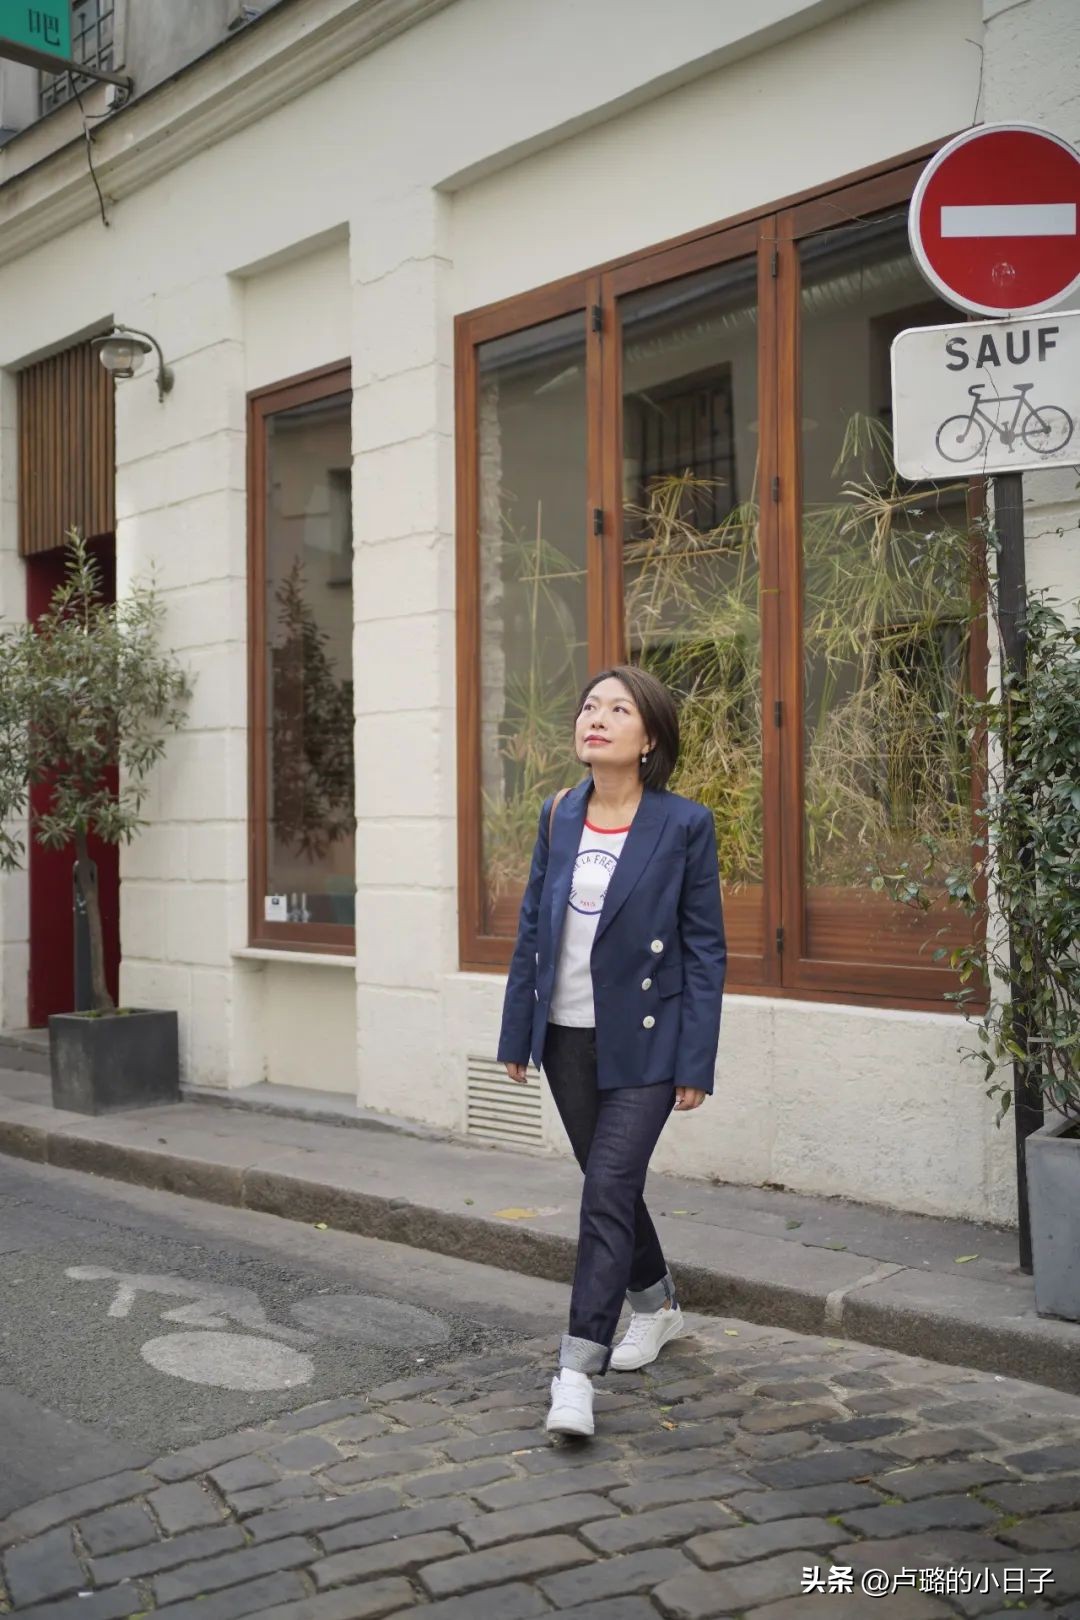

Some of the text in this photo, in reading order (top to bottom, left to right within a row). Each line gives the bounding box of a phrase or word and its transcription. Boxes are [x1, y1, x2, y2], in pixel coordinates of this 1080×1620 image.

[28, 9, 60, 46] 吧
[945, 326, 1059, 371] SAUF
[582, 856, 591, 865] LA
